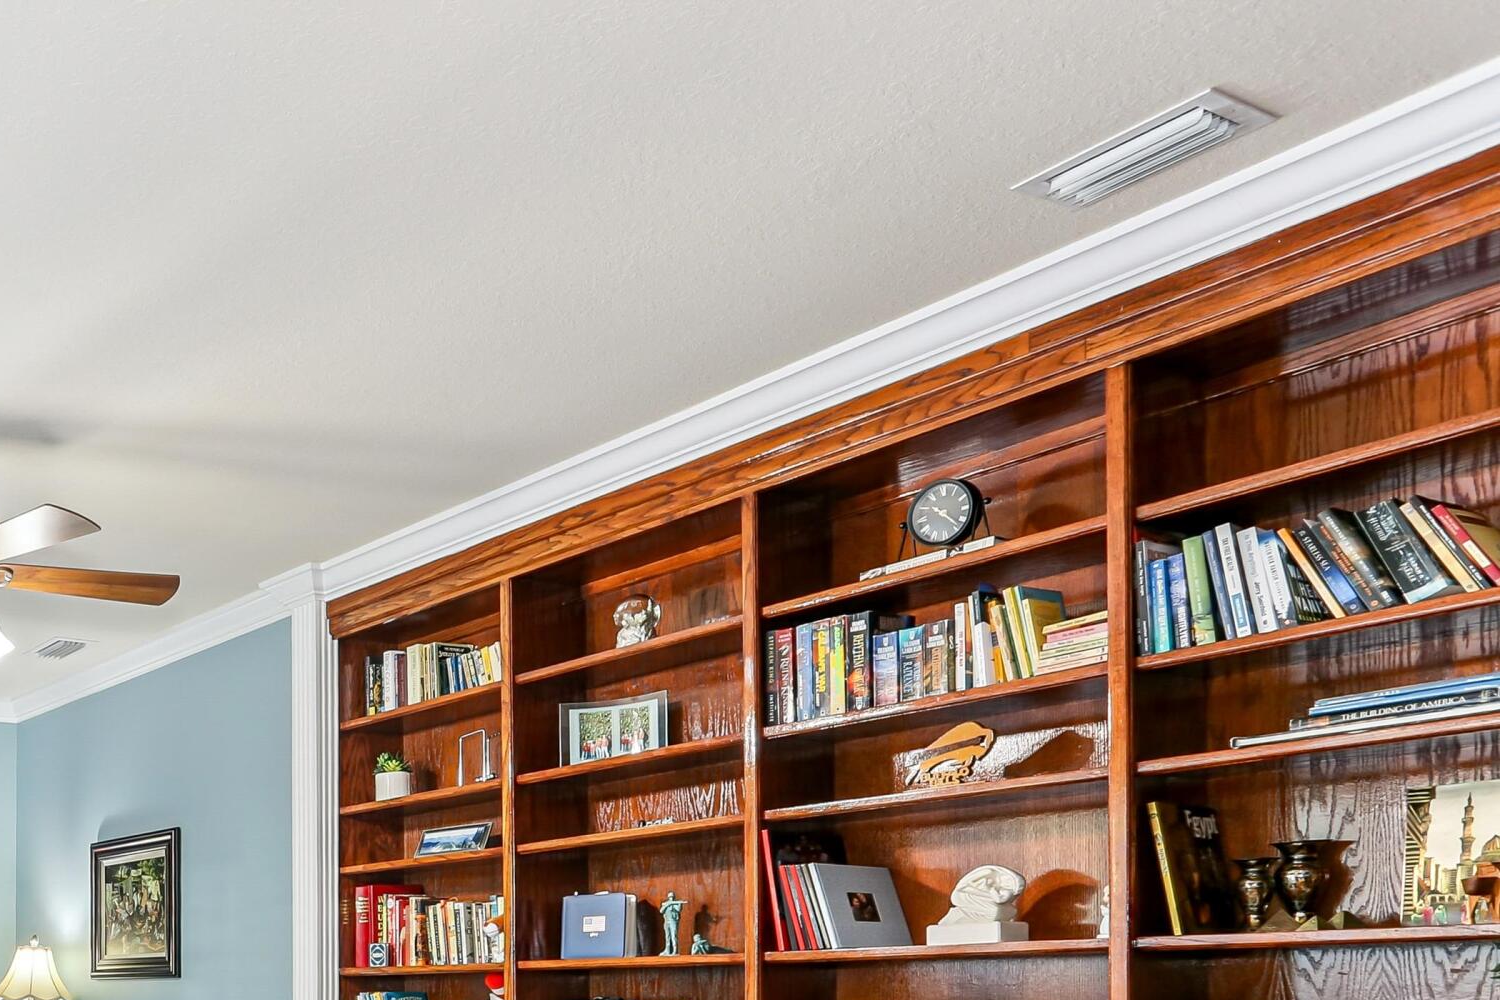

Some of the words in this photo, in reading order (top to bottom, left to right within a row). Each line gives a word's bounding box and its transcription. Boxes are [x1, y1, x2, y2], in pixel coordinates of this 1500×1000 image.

[1301, 534, 1323, 561] STARLESS
[1318, 558, 1331, 572] SEA
[1253, 580, 1262, 594] Jerry
[1256, 595, 1267, 616] Seinfeld
[1176, 606, 1190, 647] NIGHTFLYERS
[1340, 712, 1357, 721] THE
[1357, 705, 1404, 718] BUILDING
[1404, 702, 1420, 711] OF
[1419, 695, 1466, 708] AMERICA
[1184, 810, 1219, 839] Egypt
